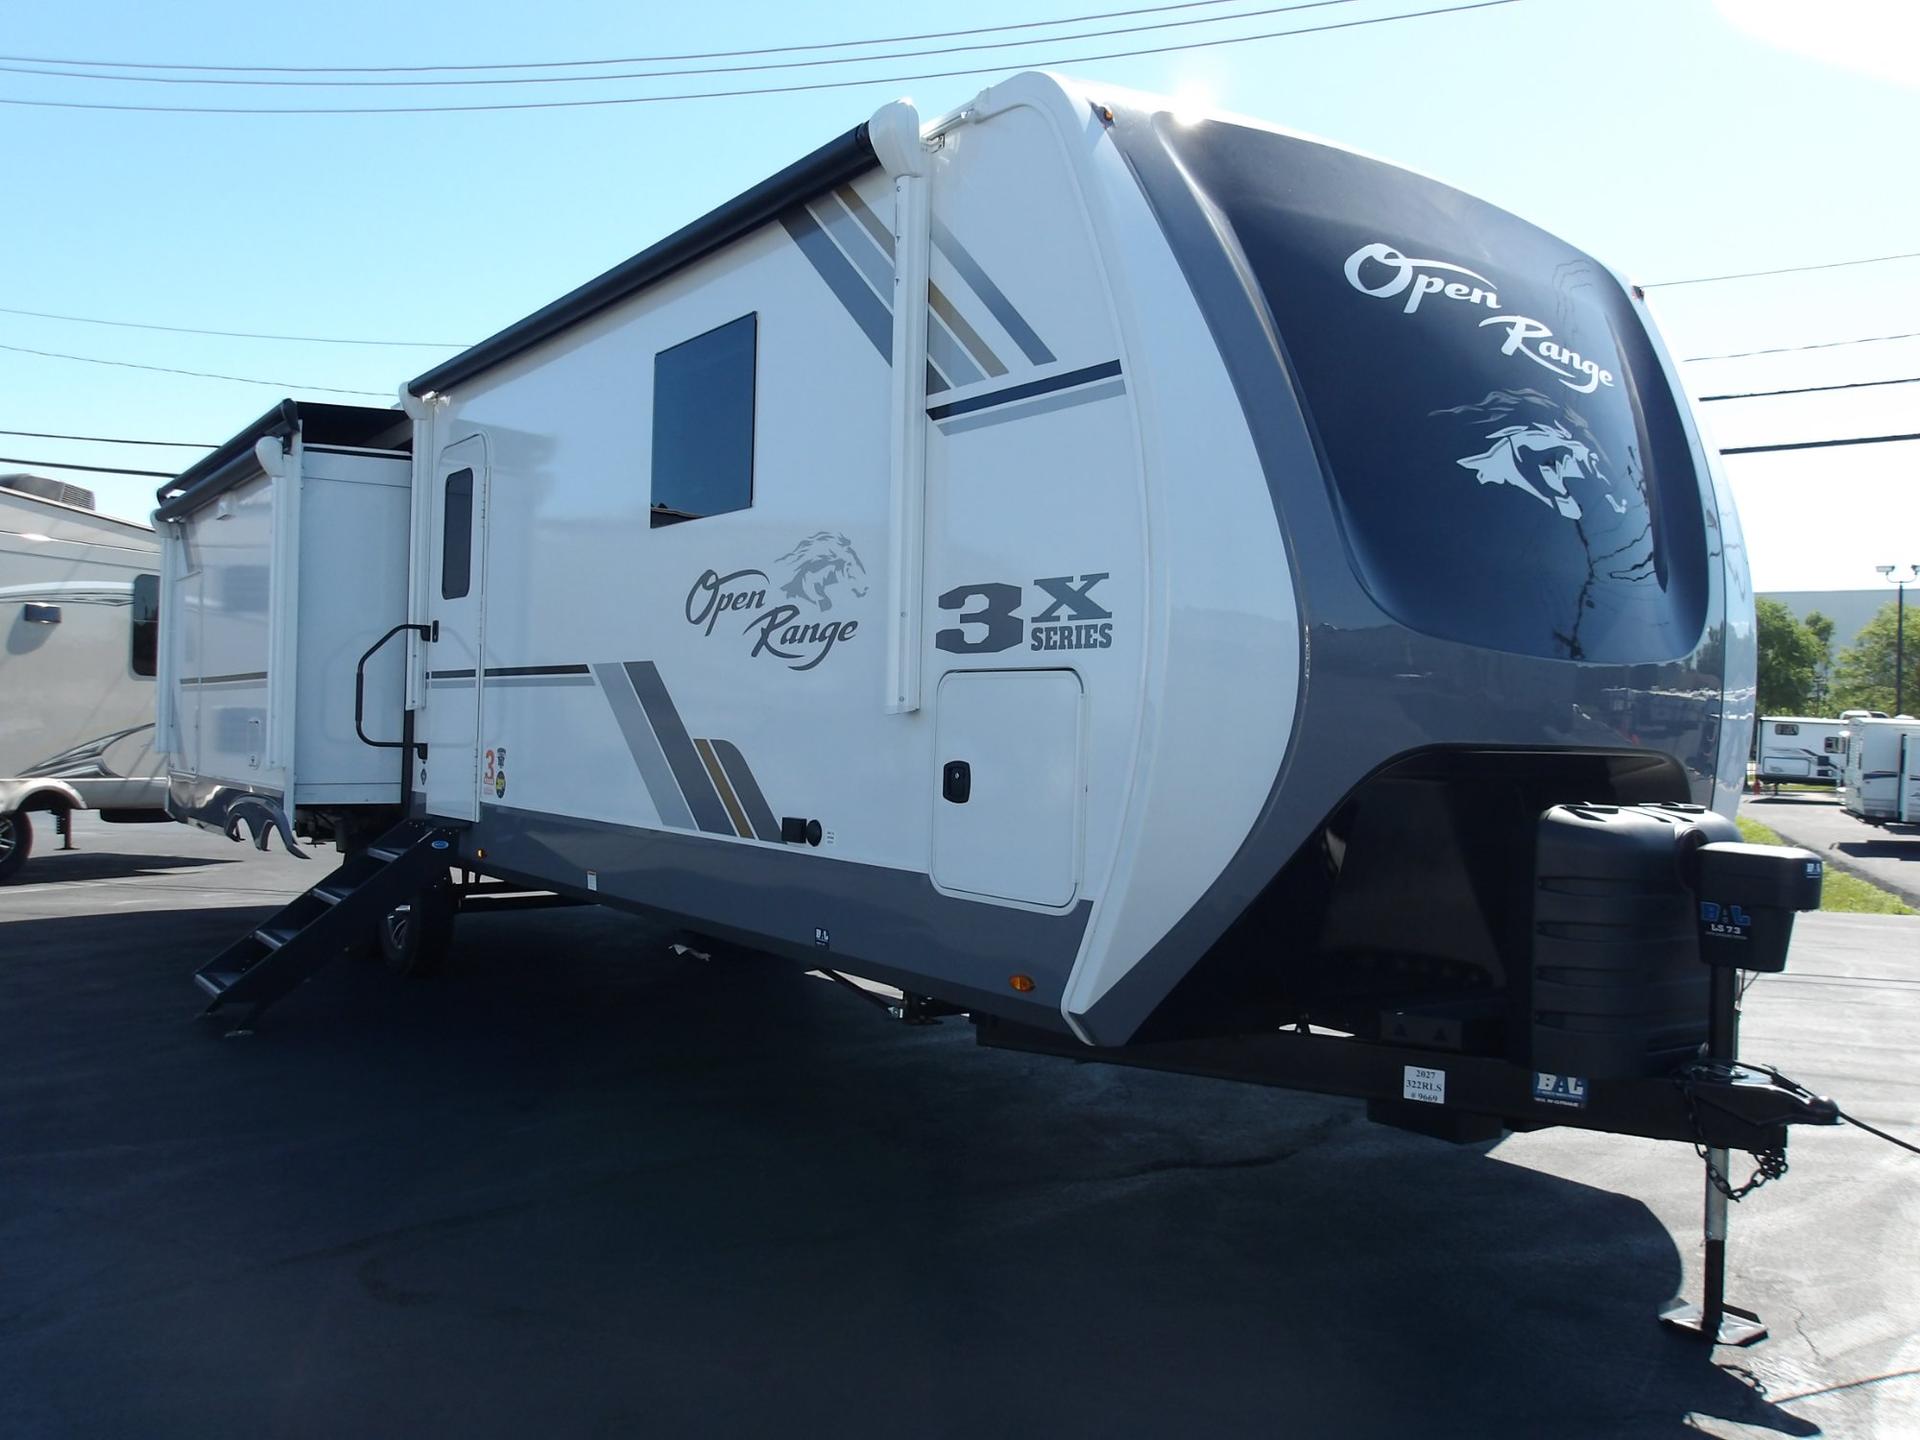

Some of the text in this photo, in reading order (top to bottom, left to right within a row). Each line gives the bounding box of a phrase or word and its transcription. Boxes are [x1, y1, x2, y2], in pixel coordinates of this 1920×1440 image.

[1344, 243, 1501, 313] Open
[1479, 315, 1614, 393] Range
[685, 568, 770, 637] Open
[742, 604, 858, 671] Range
[1030, 623, 1113, 651] SERIES
[1406, 1079, 1442, 1091] 322RLS
[1416, 1070, 1435, 1079] 2027
